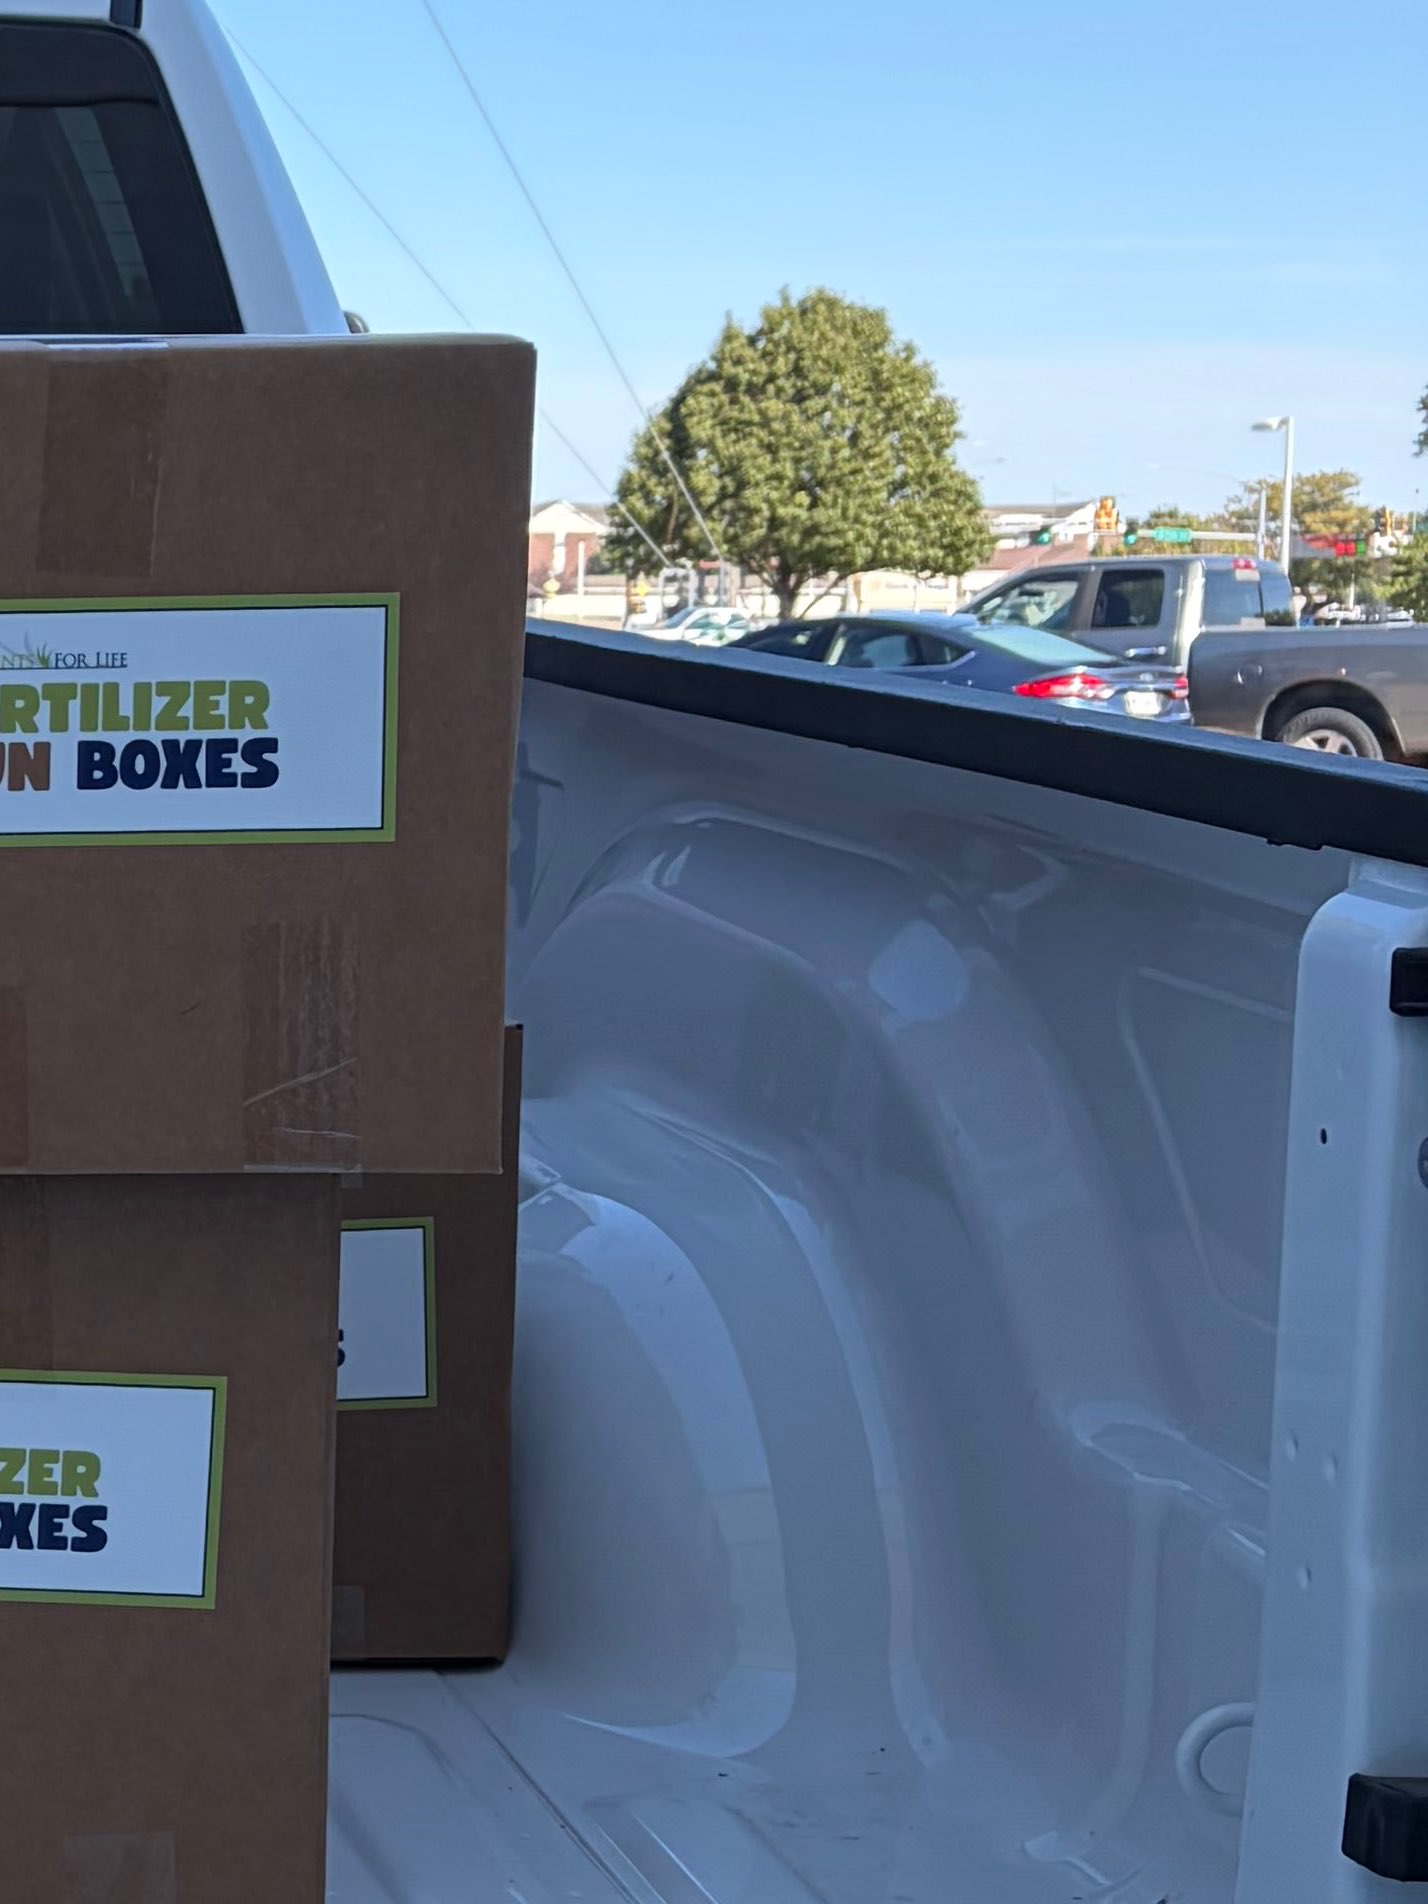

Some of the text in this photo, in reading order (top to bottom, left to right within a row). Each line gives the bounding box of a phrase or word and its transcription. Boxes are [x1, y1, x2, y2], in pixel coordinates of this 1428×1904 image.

[55, 652, 87, 669] FOR
[96, 651, 128, 668] LIFE
[76, 737, 279, 790] BOXES
